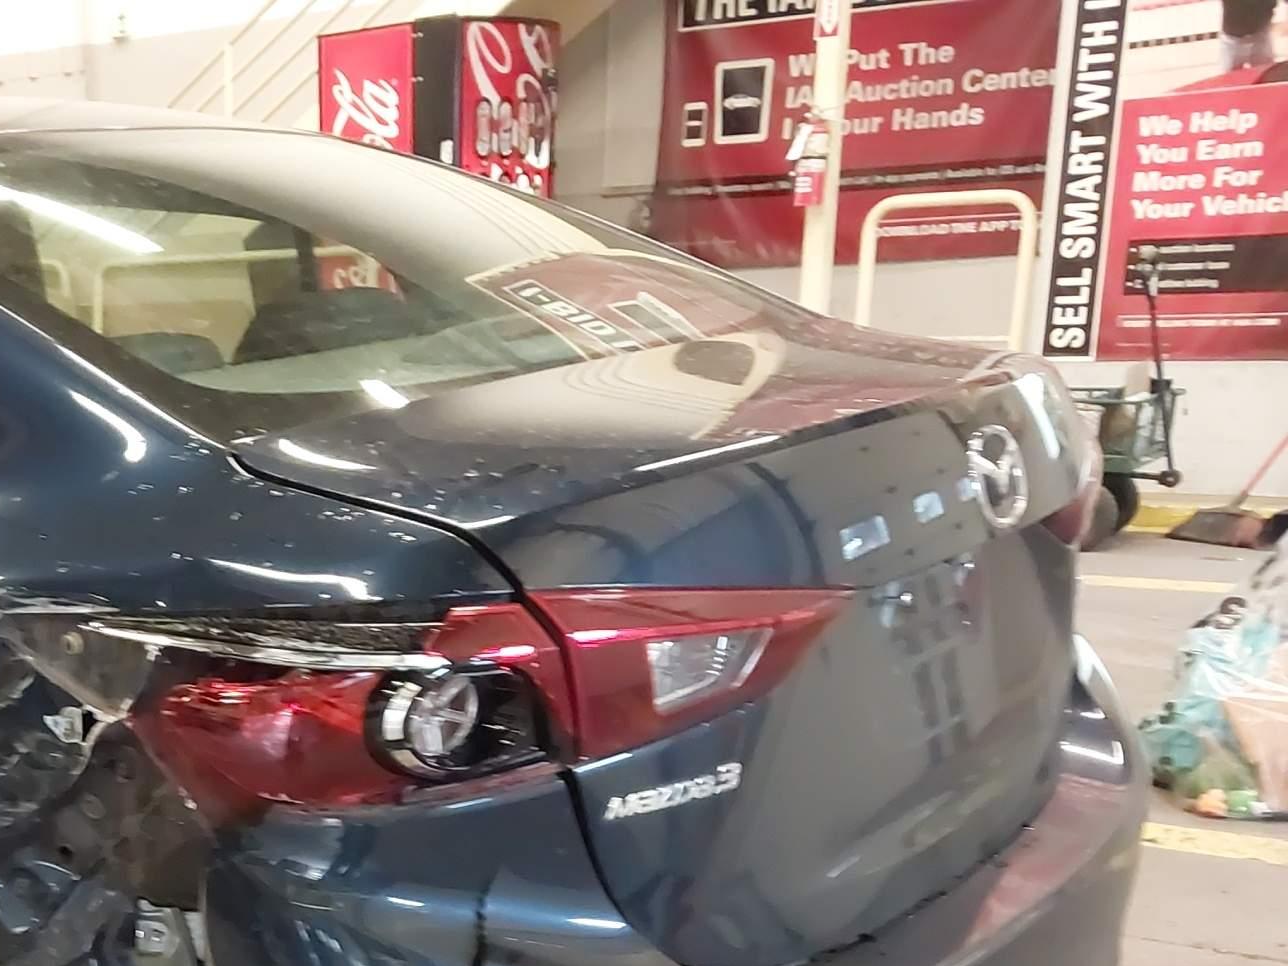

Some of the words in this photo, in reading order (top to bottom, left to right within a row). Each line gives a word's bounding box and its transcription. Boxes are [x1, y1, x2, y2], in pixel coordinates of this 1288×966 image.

[788, 53, 816, 77] W
[898, 42, 955, 66] The
[1072, 20, 1119, 122] WITH
[785, 85, 814, 109] IA
[844, 75, 954, 104] Auction
[839, 116, 884, 136] our
[891, 102, 985, 131] Hands
[1138, 115, 1183, 137] We
[1188, 108, 1258, 134] Help
[1136, 143, 1189, 164] You
[1195, 139, 1264, 161] Earn
[1059, 130, 1106, 260] SMART
[1131, 171, 1206, 192] More
[1213, 166, 1264, 188] For
[1130, 198, 1196, 219] Your
[1049, 267, 1093, 349] SELL
